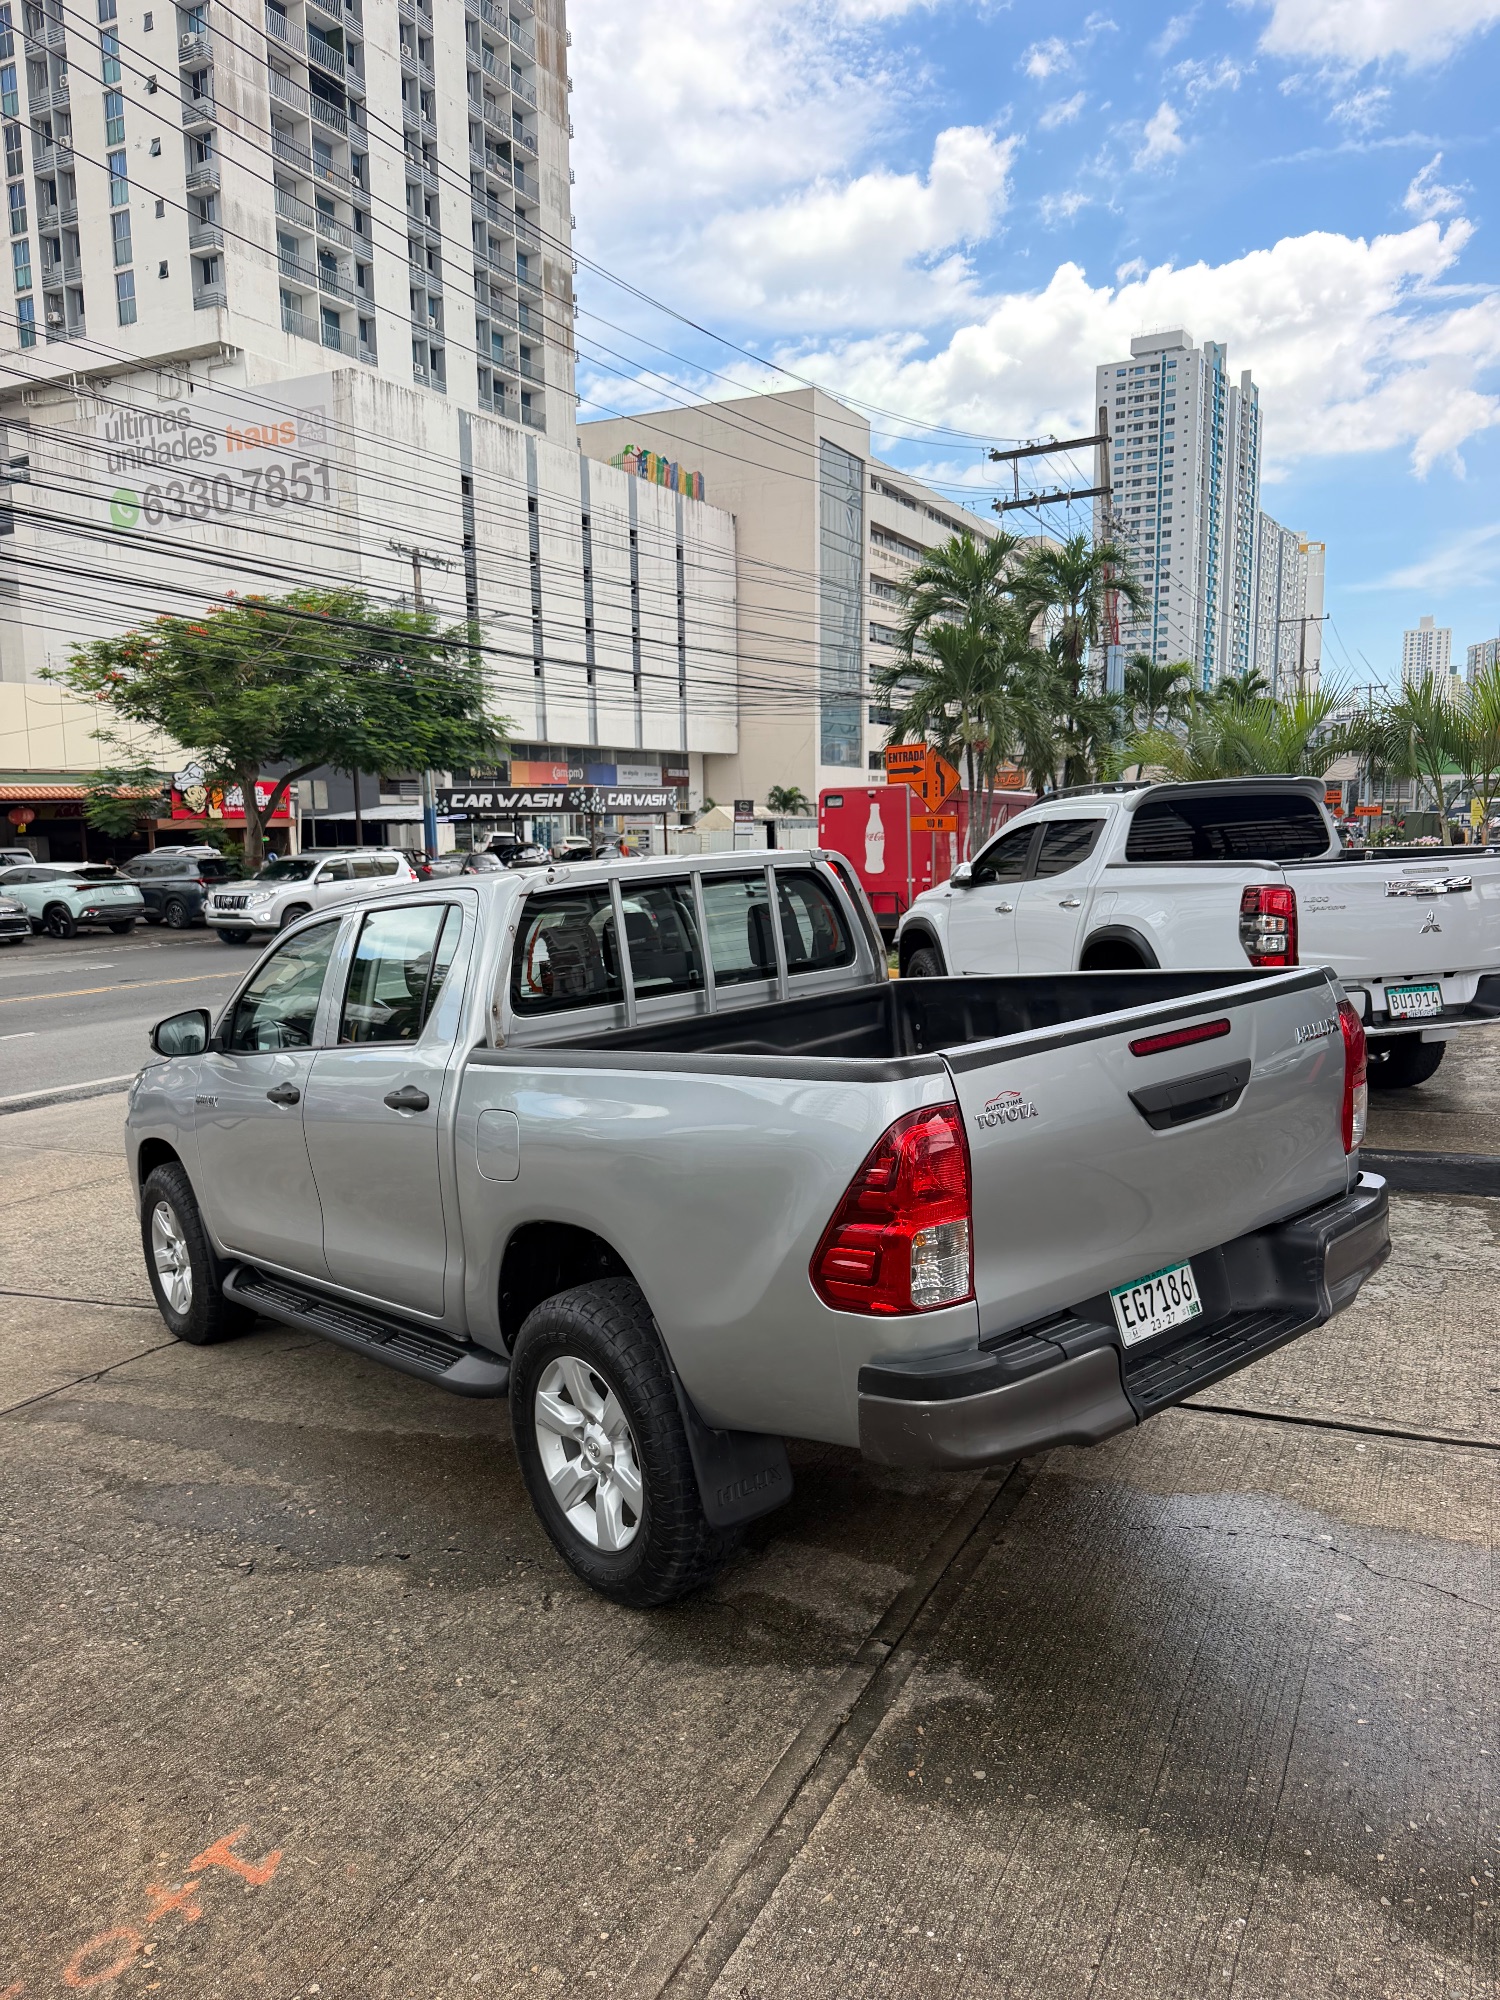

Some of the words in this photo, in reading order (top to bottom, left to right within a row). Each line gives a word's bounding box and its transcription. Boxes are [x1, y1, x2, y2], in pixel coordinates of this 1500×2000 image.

[104, 406, 192, 443] últimas
[226, 421, 296, 453] haus
[106, 431, 218, 474] unidades
[143, 458, 331, 526] 6330-7851
[888, 750, 925, 763] ENTRADA
[451, 793, 493, 808] CAR
[497, 793, 564, 808] WASH
[607, 793, 632, 806] CAR
[633, 793, 667, 806] WASH
[1392, 992, 1438, 1010] BU1914
[974, 1101, 1038, 1129] TOYOTA
[985, 1103, 1005, 1112] AUTO
[1006, 1098, 1023, 1107] TIME
[1119, 1269, 1192, 1328] EG7186
[716, 1464, 783, 1507] HILUX
